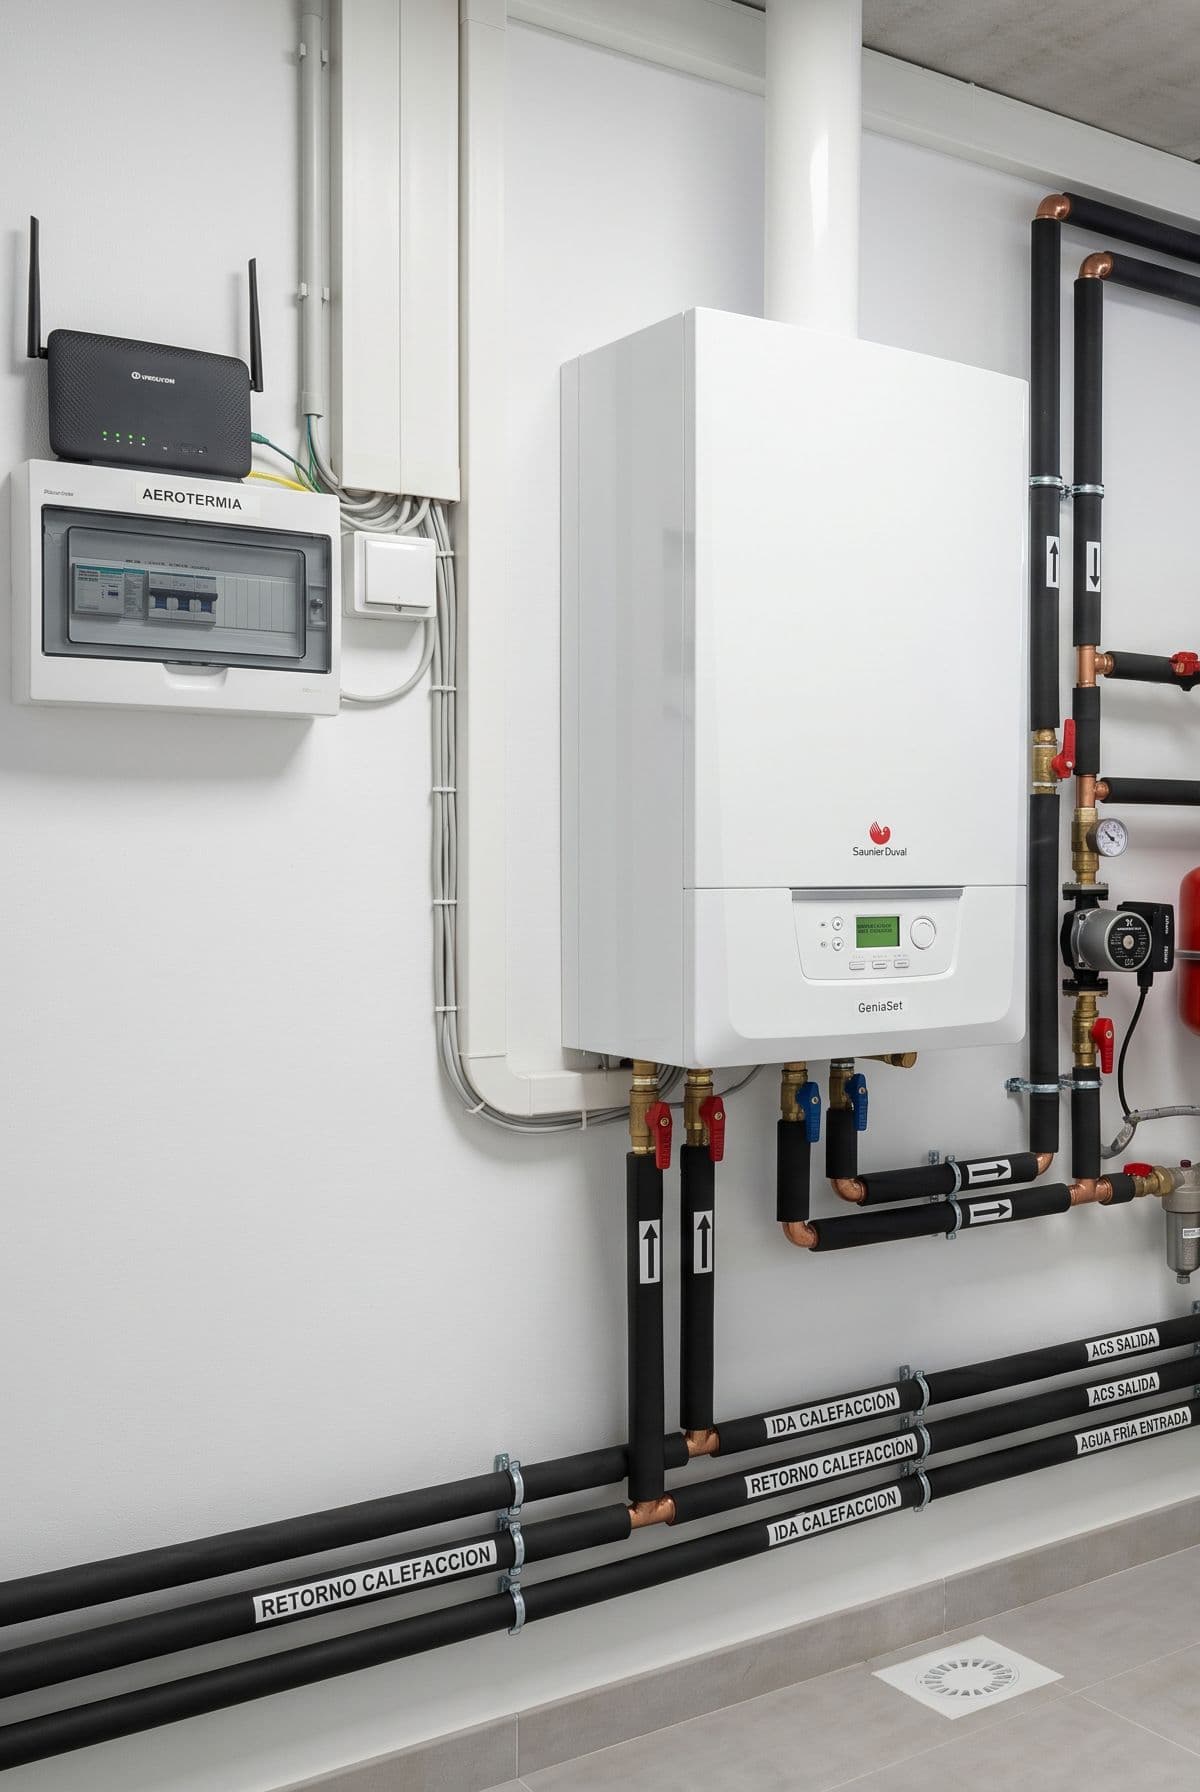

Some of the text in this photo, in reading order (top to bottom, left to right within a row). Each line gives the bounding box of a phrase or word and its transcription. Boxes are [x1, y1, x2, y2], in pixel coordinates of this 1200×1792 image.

[142, 488, 243, 511] AEROTERMIA
[852, 846, 907, 857] Saunier Duval
[858, 1000, 903, 1013] GeniaSet
[1092, 1331, 1156, 1358] ACS SALIDA
[1093, 1376, 1156, 1403] ACS SALIDA
[771, 1415, 797, 1435] IDA
[1080, 1431, 1111, 1451] AGUA
[1139, 1410, 1188, 1435] ENTRADA
[751, 1463, 819, 1494] RETORNO
[774, 1490, 897, 1541] IDA CALEFACCION
[261, 1545, 491, 1618] RETORNO CALEFACCION
